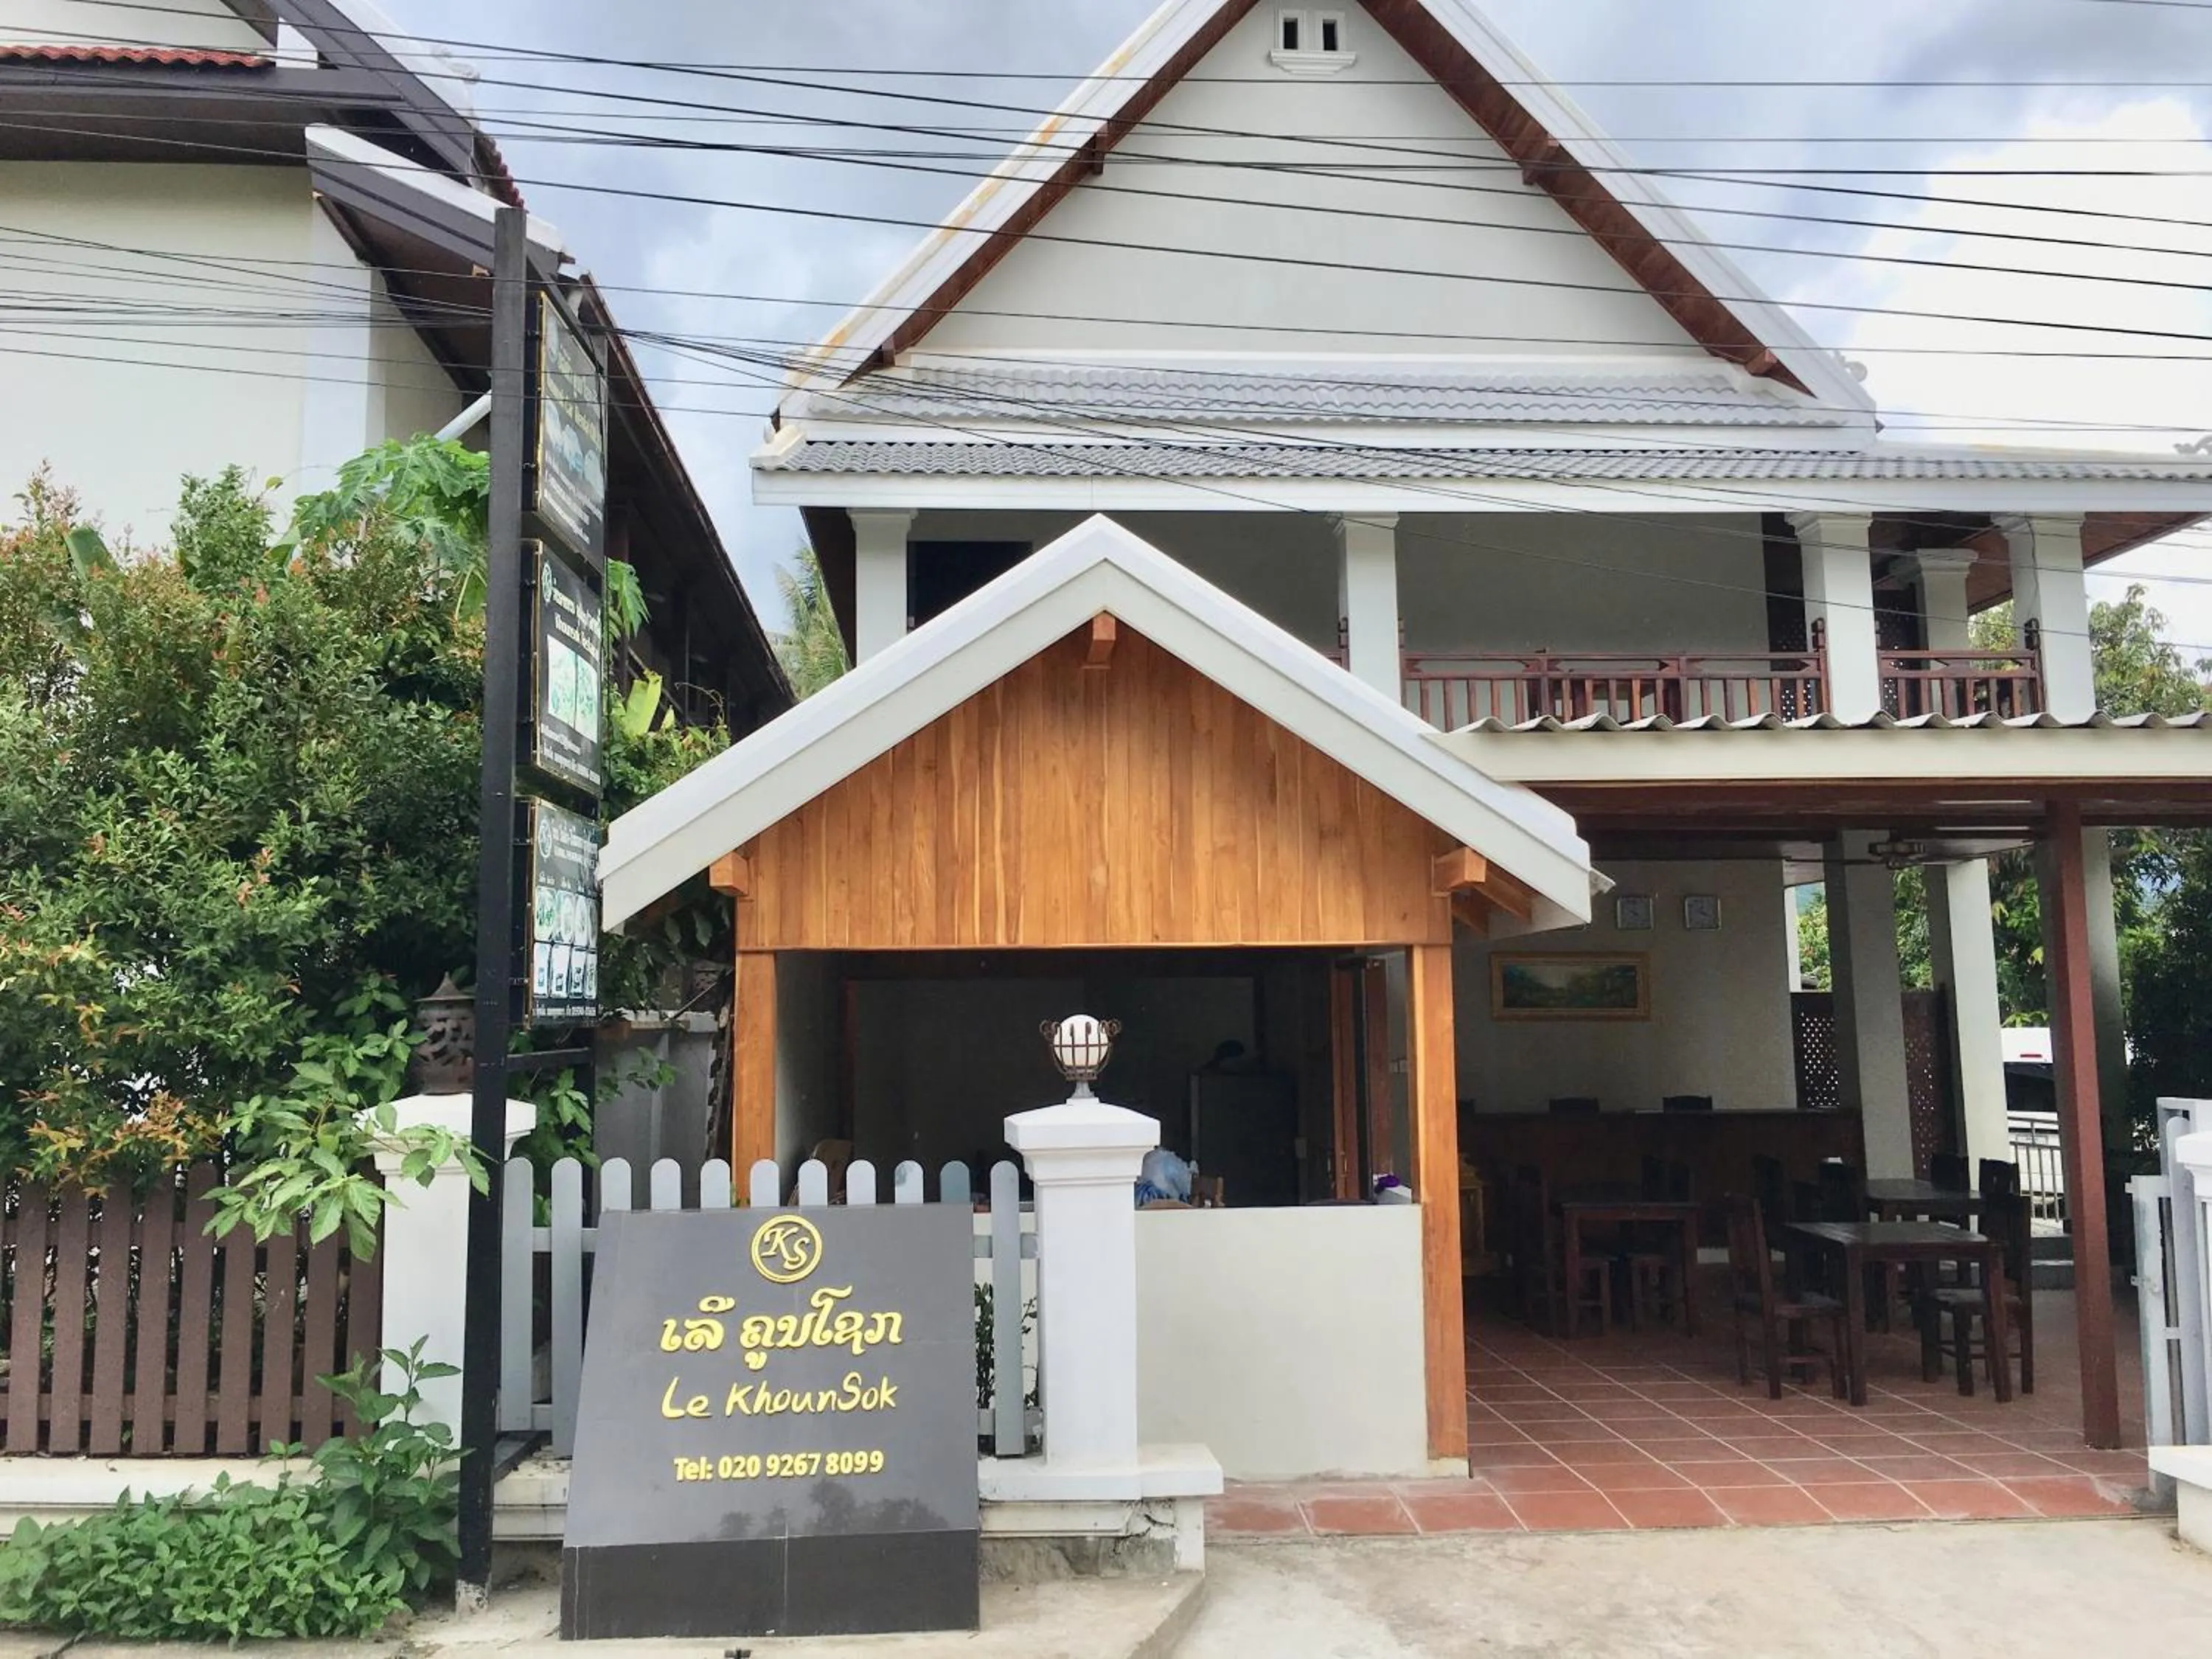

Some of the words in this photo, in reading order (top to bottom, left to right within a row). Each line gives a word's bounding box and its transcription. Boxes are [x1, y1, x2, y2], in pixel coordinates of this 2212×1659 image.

[760, 1225, 811, 1271] KS
[661, 1377, 712, 1419] Le
[725, 1371, 899, 1417] KhounSok
[673, 1457, 713, 1482] Tel:
[717, 1455, 762, 1480] 020
[766, 1452, 822, 1478] 9267
[824, 1450, 884, 1475] 8099
